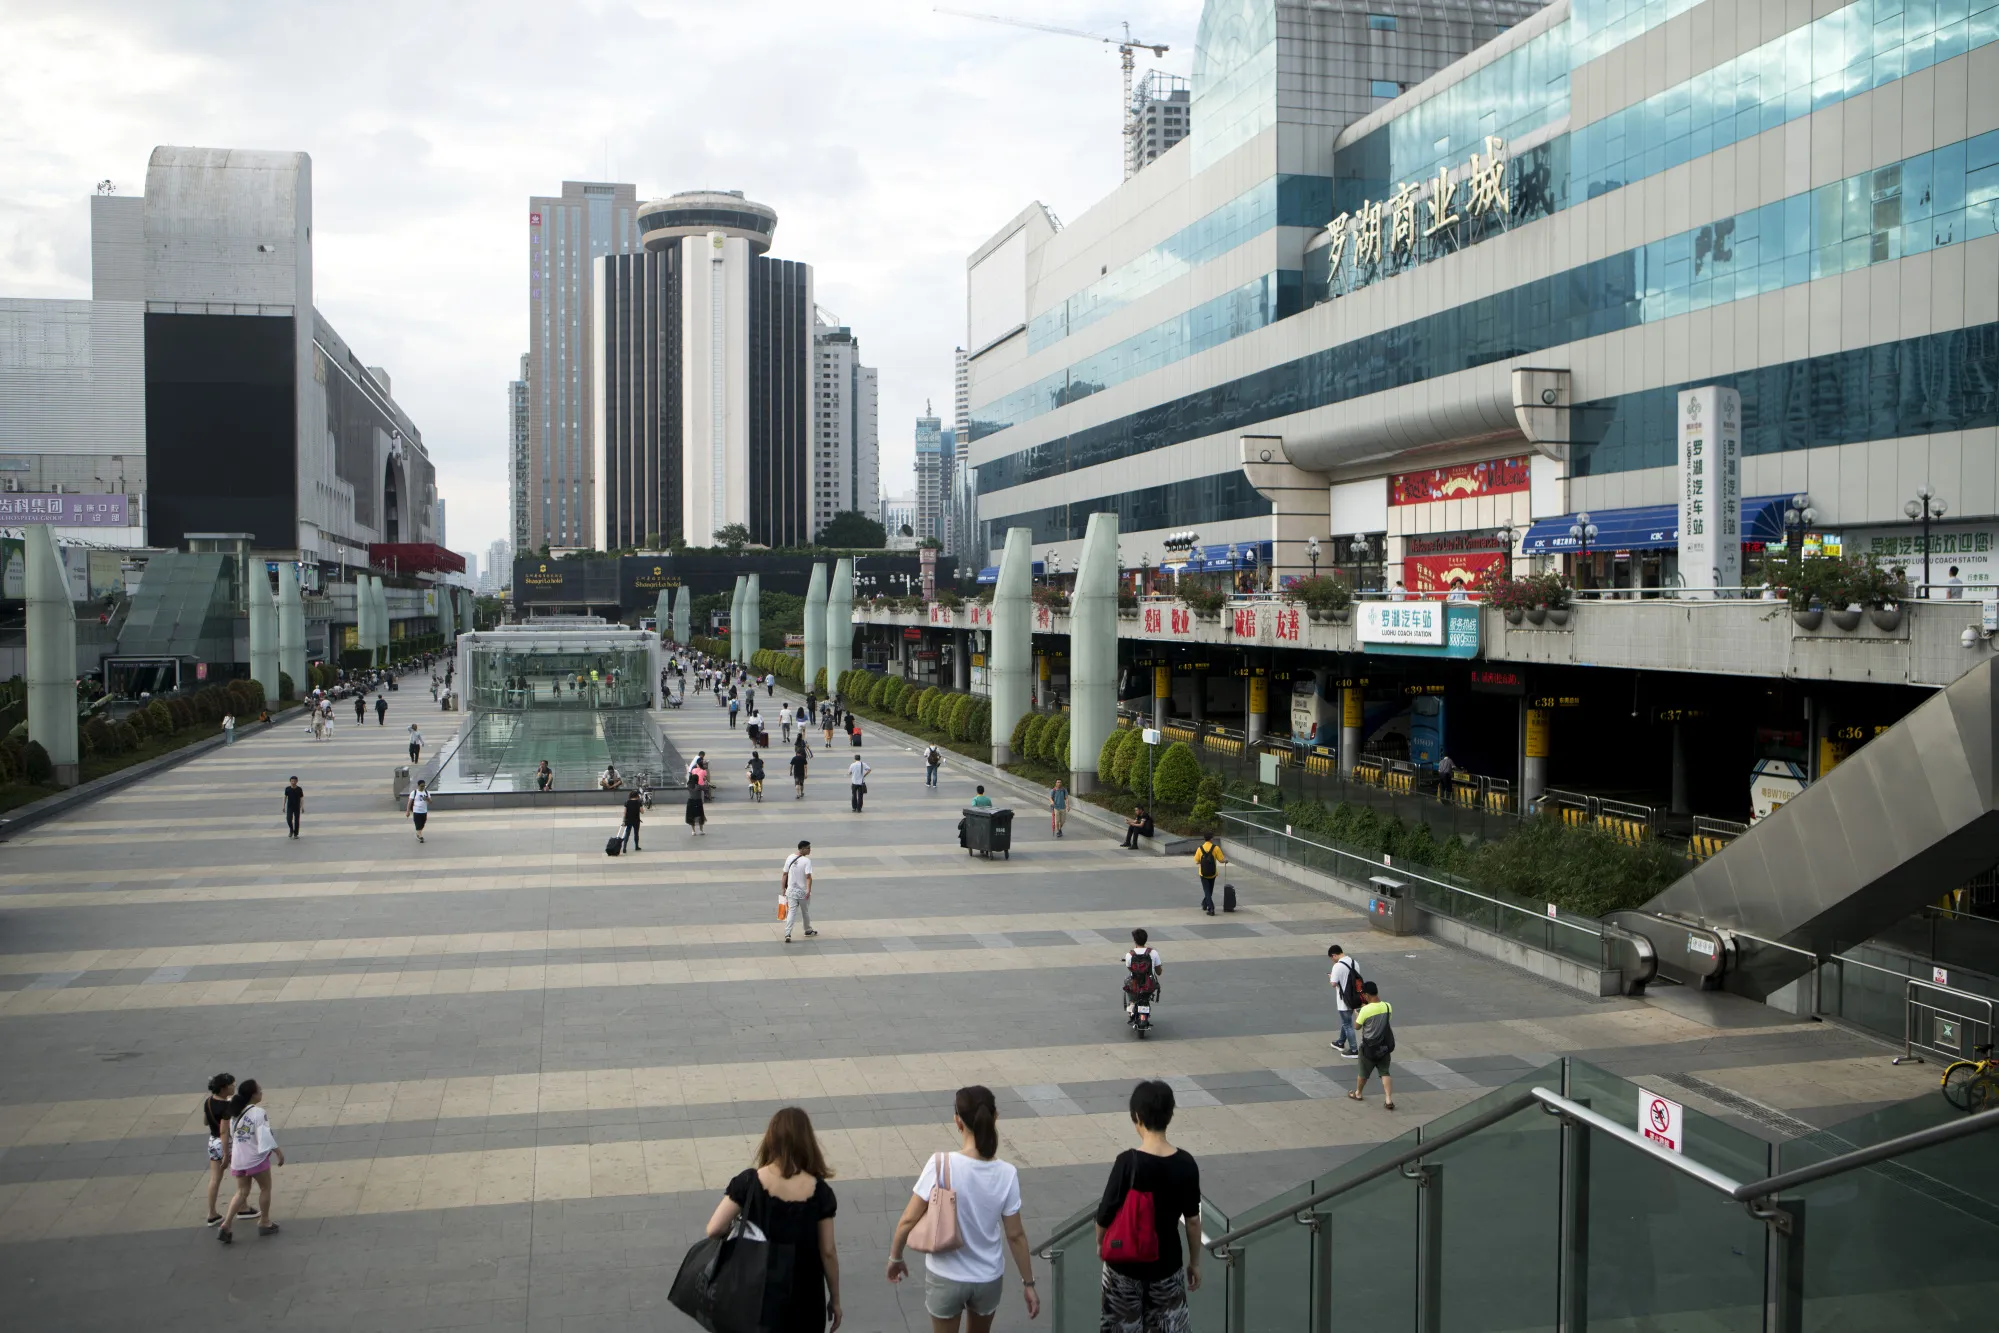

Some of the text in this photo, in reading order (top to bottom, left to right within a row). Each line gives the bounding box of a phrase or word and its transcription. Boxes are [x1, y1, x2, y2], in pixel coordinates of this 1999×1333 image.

[1324, 136, 1509, 284] 罗湖商业城
[1693, 440, 1703, 534] 罗湖汽车站
[1650, 532, 1664, 541] ICBC
[1935, 556, 1957, 564] COACH
[1958, 556, 1988, 564] STATION
[1144, 608, 1190, 635] 爱国 敬业
[1234, 609, 1300, 641] 诚信 友善
[1381, 609, 1432, 628] 罗湖汽车站
[1449, 618, 1477, 632] 服务热线
[1413, 630, 1432, 638] STATION
